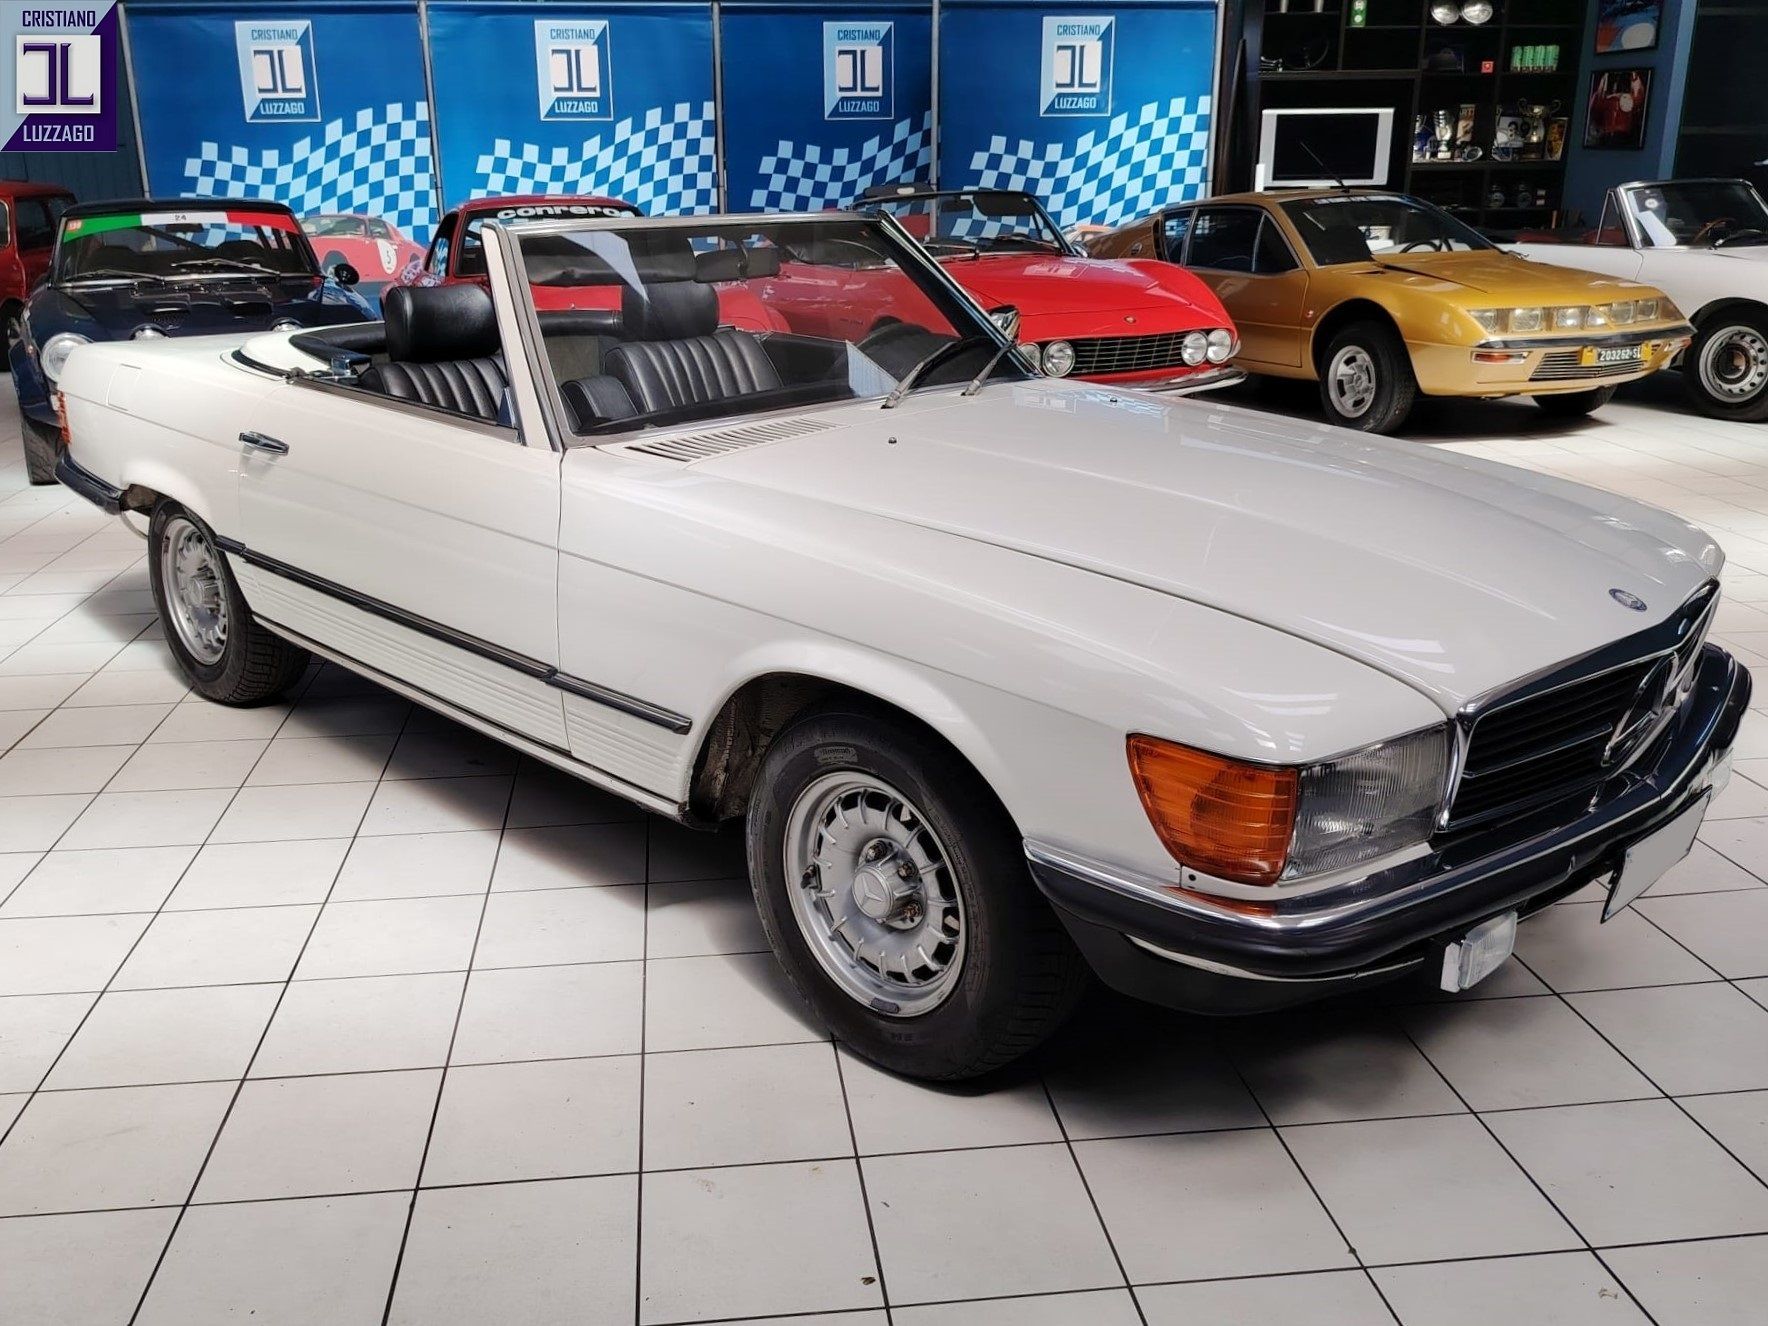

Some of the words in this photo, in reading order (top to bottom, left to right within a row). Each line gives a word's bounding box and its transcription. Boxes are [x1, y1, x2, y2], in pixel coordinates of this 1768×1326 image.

[251, 29, 299, 41] CRISTIANO
[550, 28, 596, 41] CRISTIANO
[837, 29, 881, 41] CRISTIANO
[1057, 24, 1101, 36] CRISTIANO
[259, 101, 306, 116] LUZZAGO
[554, 100, 599, 114] LUZZAGO
[838, 100, 880, 114] LUZZAGO
[1054, 97, 1097, 109] LUZZAGO
[498, 206, 620, 219] conrero
